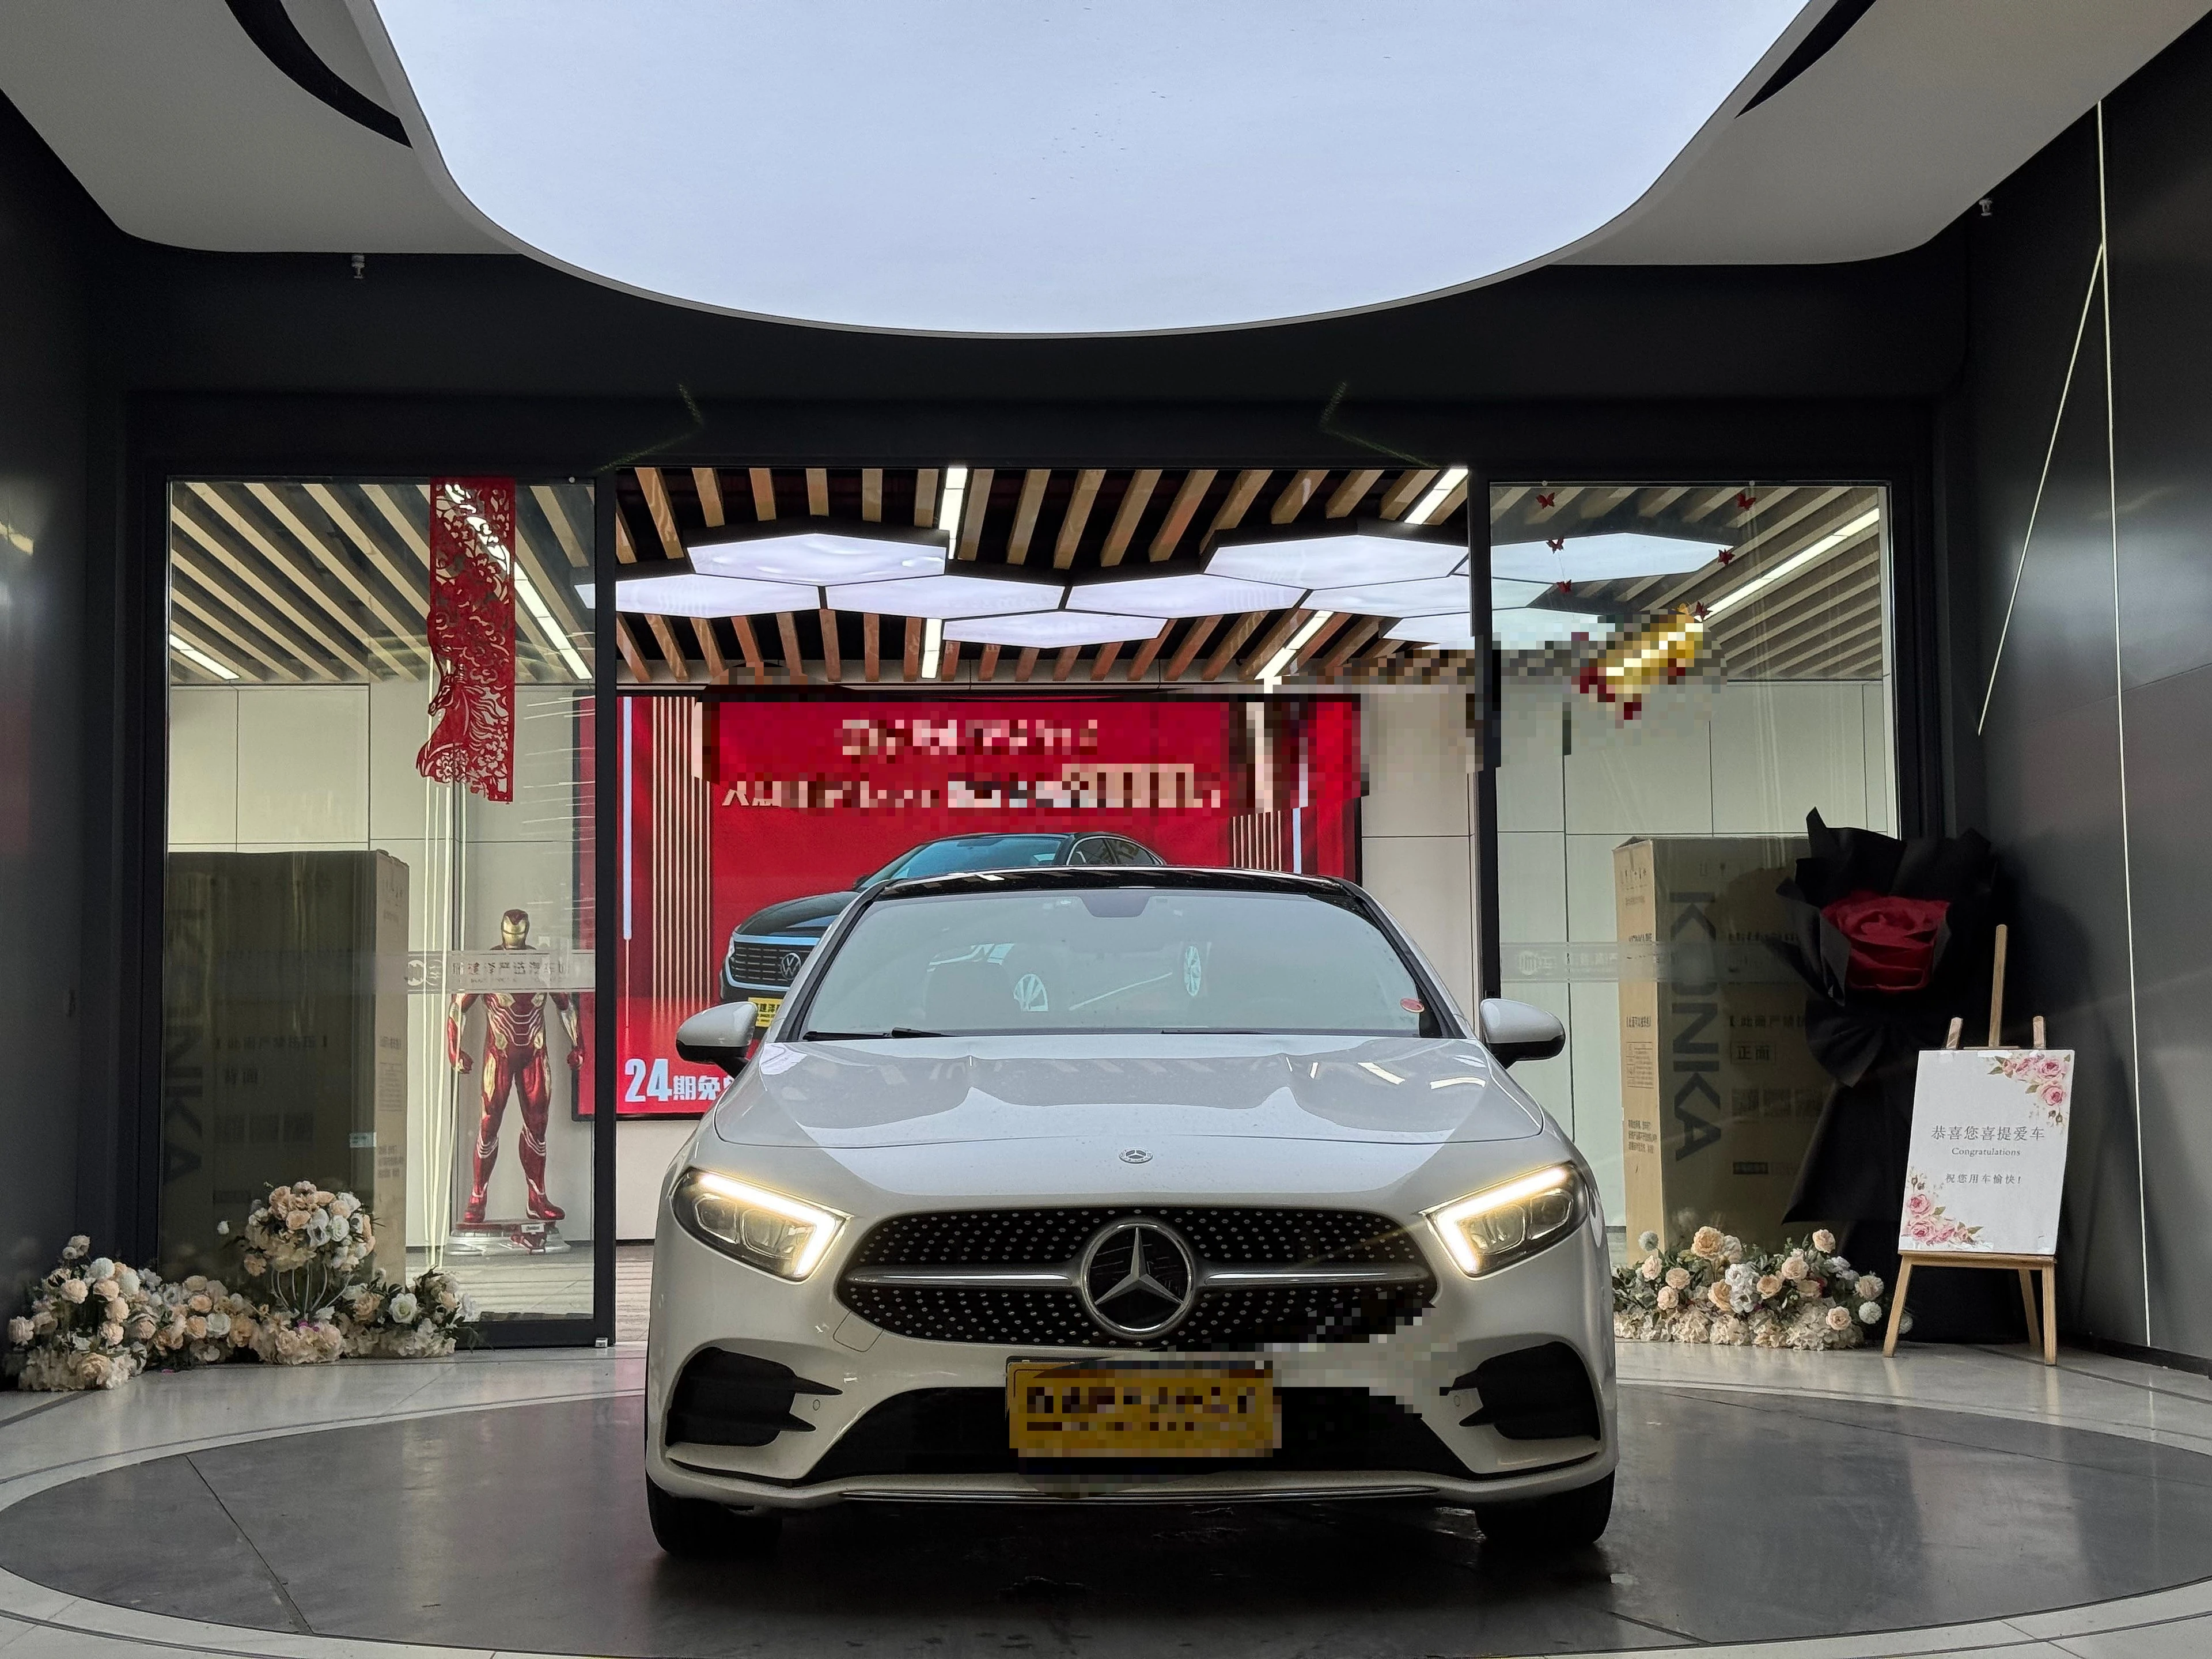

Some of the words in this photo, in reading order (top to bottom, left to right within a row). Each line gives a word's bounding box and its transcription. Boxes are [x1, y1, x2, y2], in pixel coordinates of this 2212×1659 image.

[1669, 892, 1721, 1162] KONKA
[1737, 1045, 1770, 1062] 正面
[1931, 1125, 2045, 1142] 恭喜您喜提爱车
[1951, 1147, 2021, 1157] Congratulations
